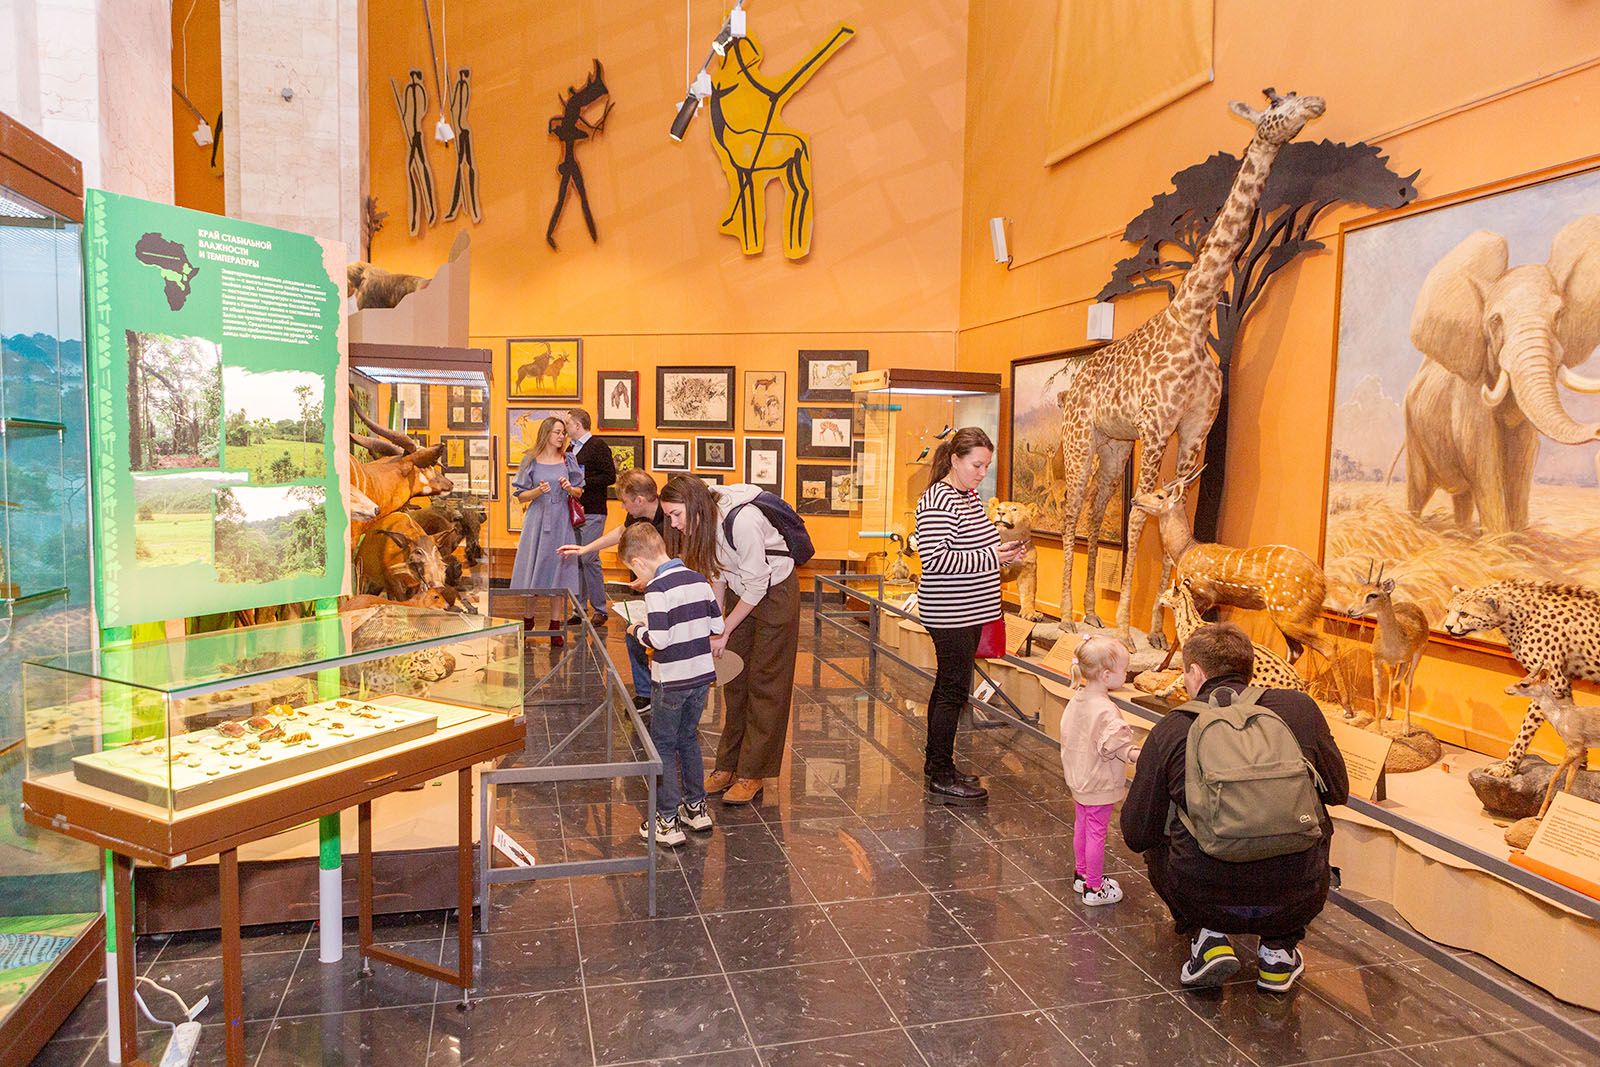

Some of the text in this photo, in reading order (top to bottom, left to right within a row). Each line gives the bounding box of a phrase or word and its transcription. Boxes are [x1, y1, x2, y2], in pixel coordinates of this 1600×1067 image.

[198, 229, 272, 250] КРАЙ СТАБИЛЬНОЙ
[198, 240, 249, 256] ВЛАЖНОСТИ
[198, 250, 259, 268] И ТЕМПЕРАТУРЫ
